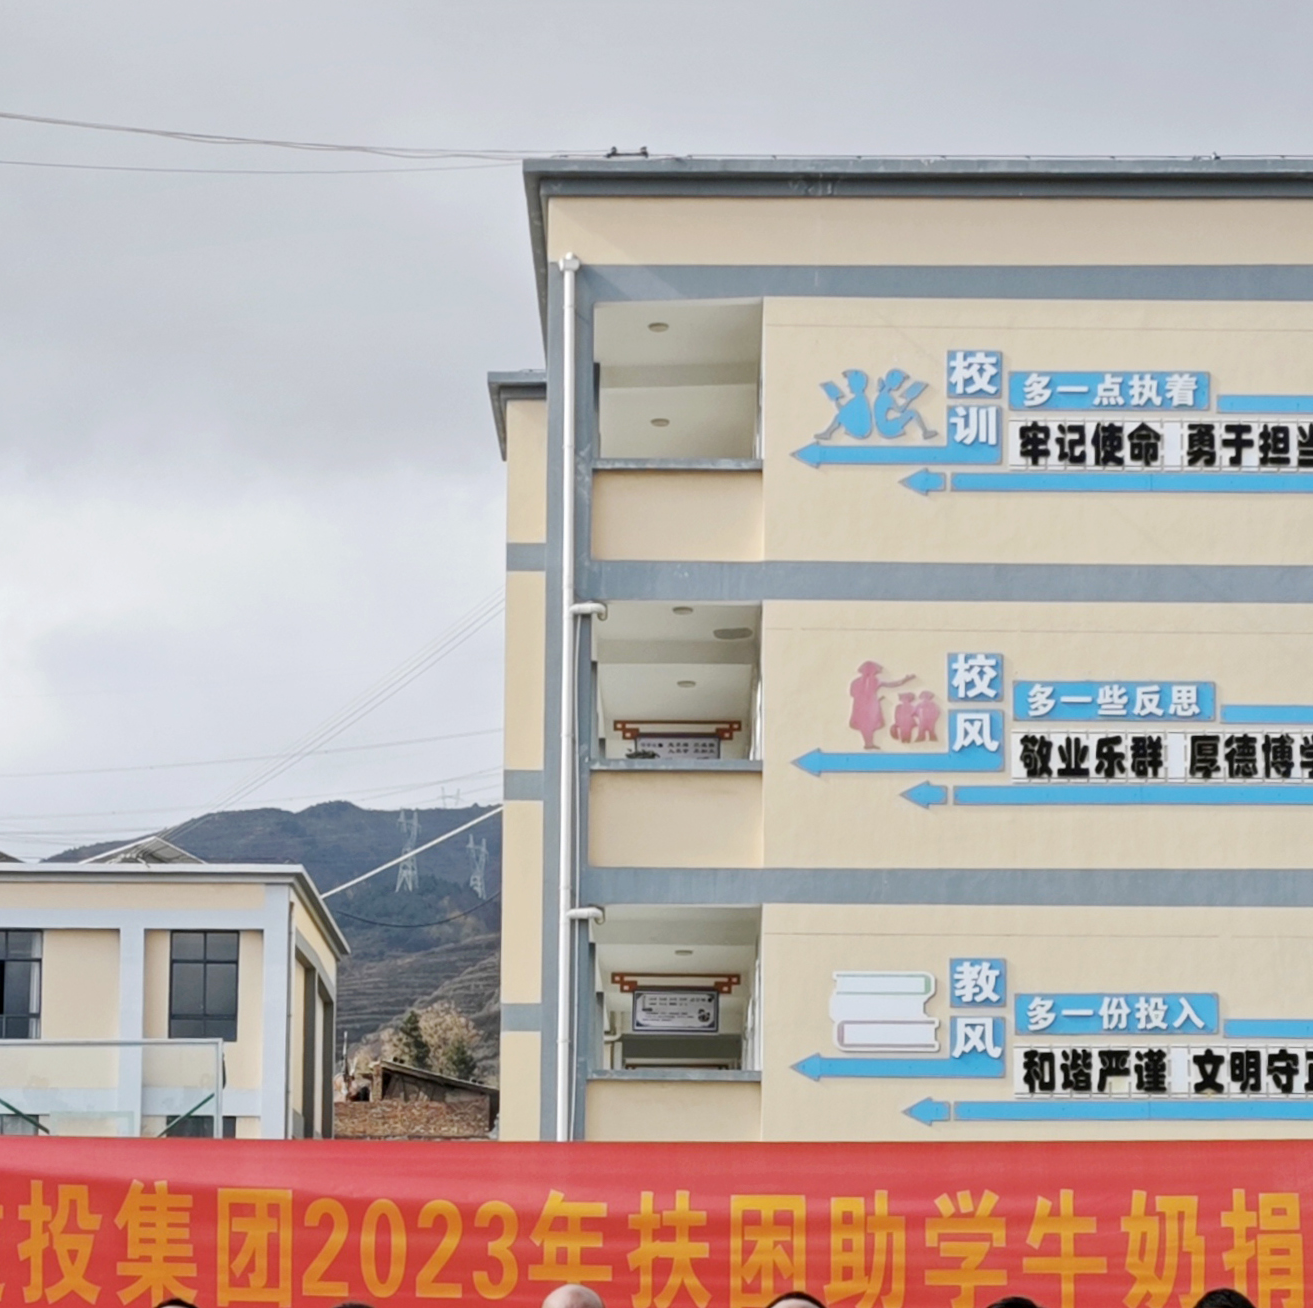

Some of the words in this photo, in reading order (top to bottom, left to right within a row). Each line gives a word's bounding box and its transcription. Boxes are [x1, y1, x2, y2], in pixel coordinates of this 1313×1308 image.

[948, 353, 998, 447] 校训
[1022, 374, 1199, 408] 多一点执着
[1018, 424, 1162, 467] 牢记使命
[951, 654, 998, 753] 校风
[1026, 684, 1201, 717] 多一些反思
[1019, 735, 1165, 778] 敬业乐群
[952, 960, 1003, 1062] 教风
[1026, 996, 1205, 1032] 多一份投入
[1021, 1048, 1168, 1097] 和谐严谨
